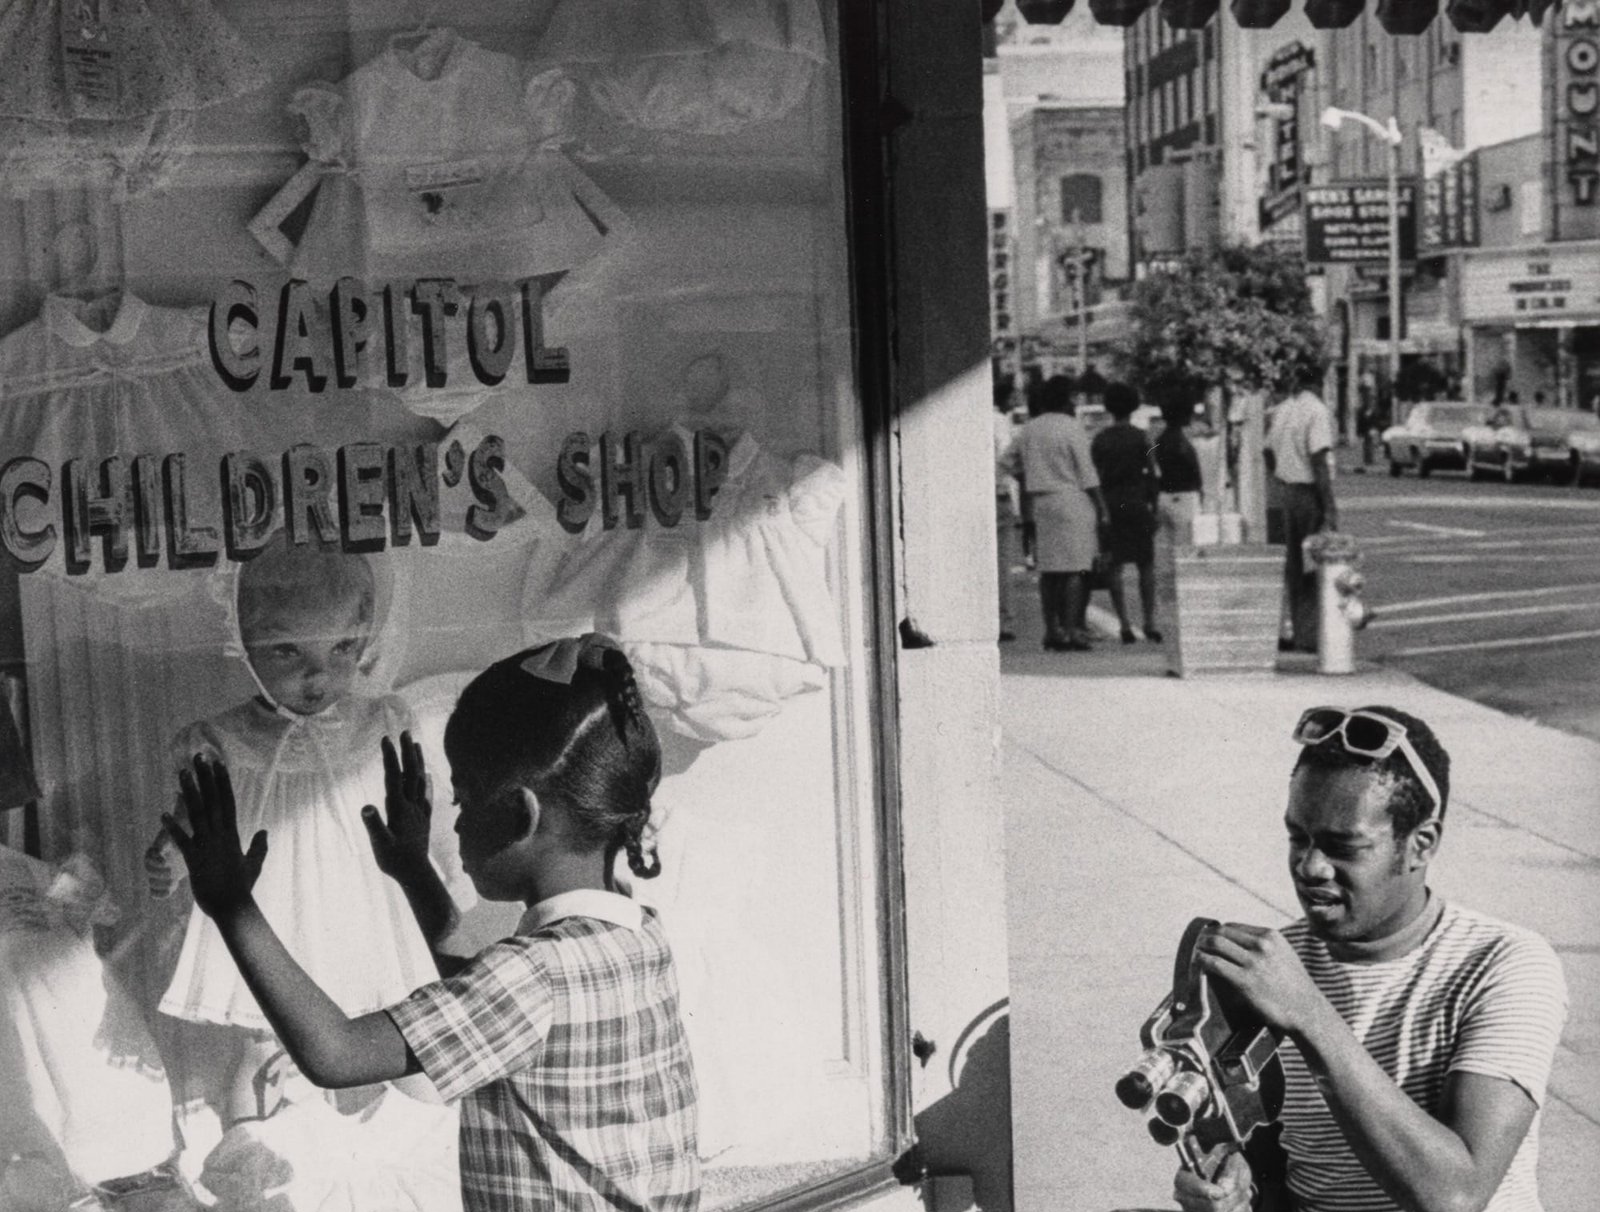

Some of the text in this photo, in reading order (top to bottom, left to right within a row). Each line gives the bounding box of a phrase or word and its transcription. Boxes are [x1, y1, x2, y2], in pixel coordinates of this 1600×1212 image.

[1280, 84, 1296, 181] HTEL
[1358, 205, 1408, 219] STOE
[208, 279, 570, 391] CAPITOL
[0, 428, 732, 575] CHILDREN'S SHOP
